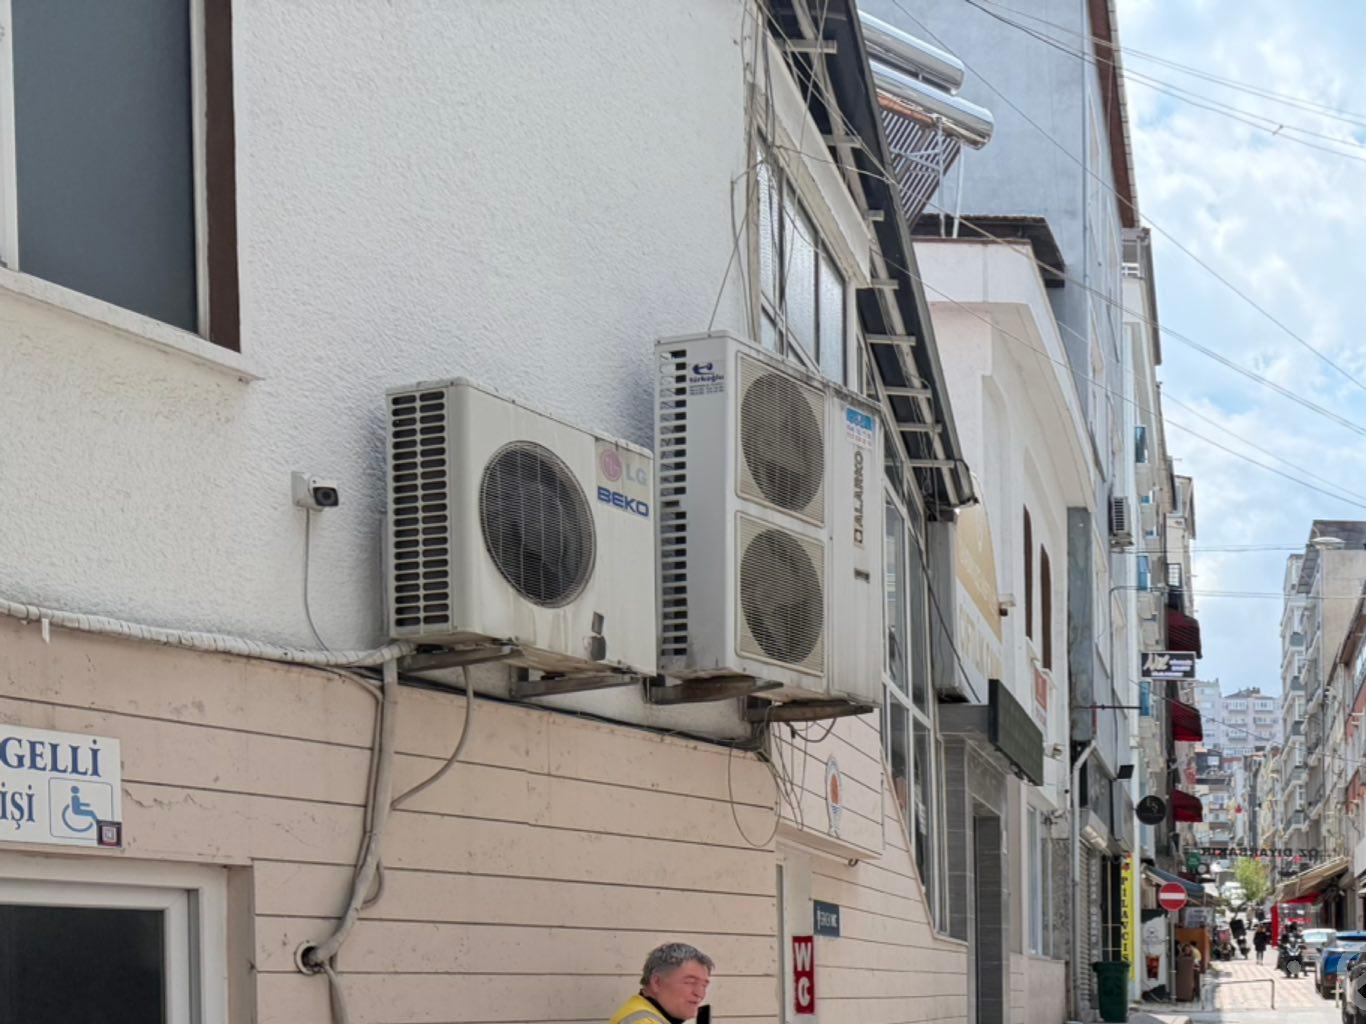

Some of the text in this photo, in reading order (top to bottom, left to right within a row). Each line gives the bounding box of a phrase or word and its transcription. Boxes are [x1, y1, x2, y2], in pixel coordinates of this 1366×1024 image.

[597, 486, 649, 517] BEKO
[853, 450, 864, 523] ALARKO
[0, 737, 102, 778] GELLİ
[794, 942, 813, 1007] WC
